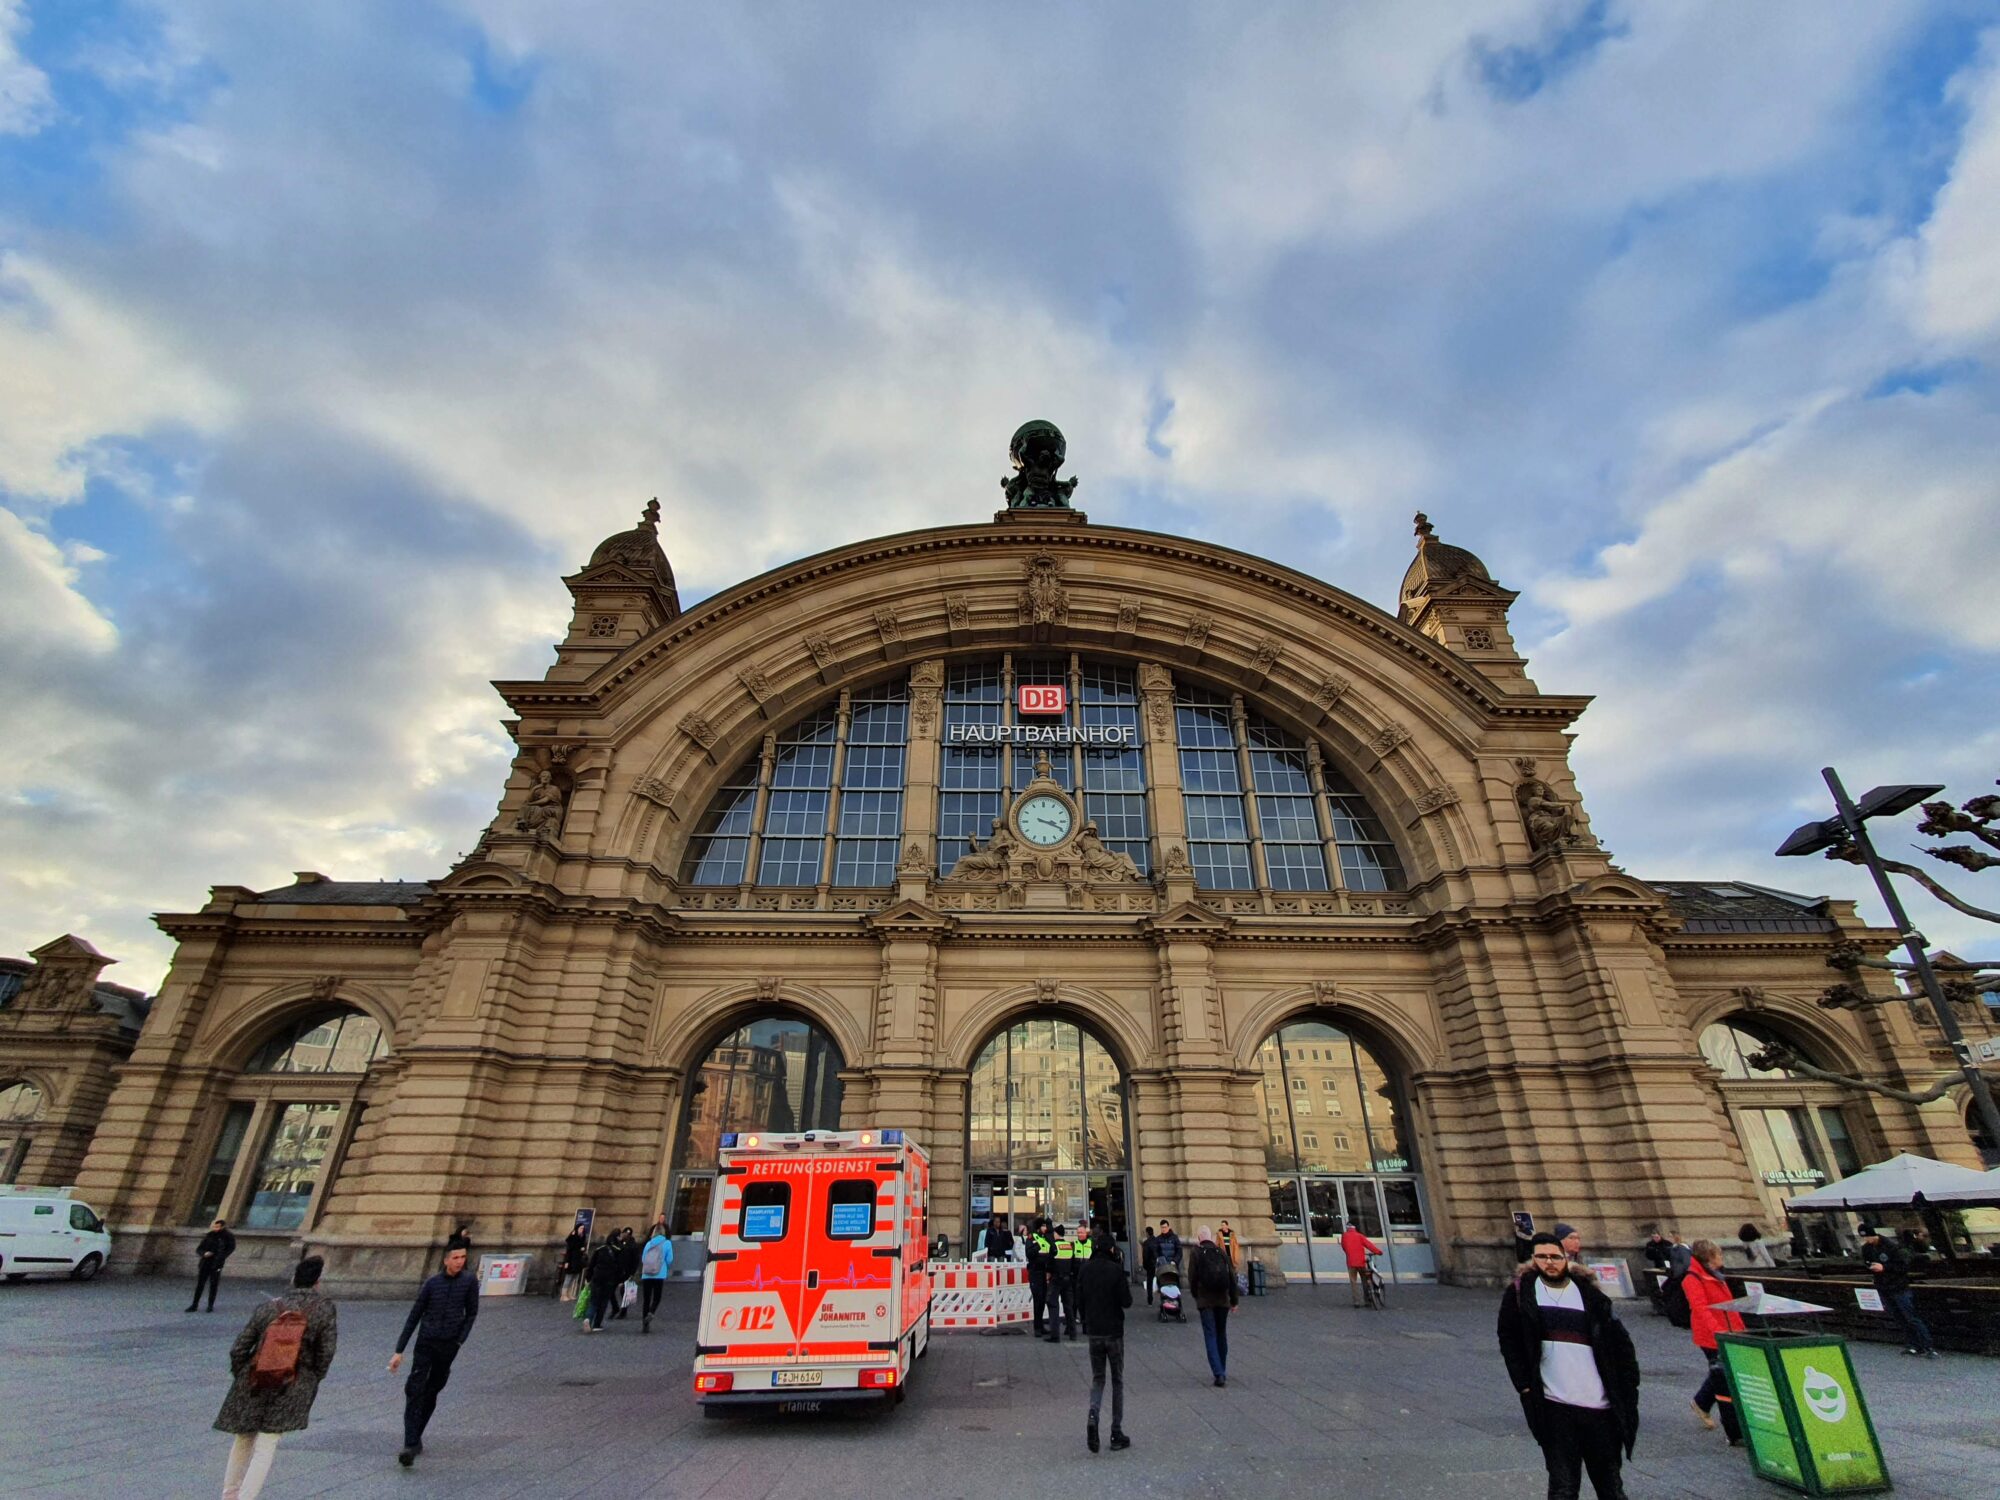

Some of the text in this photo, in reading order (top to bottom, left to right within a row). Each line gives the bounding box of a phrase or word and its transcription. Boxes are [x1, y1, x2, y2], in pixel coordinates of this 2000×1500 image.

[1025, 689, 1059, 708] DB
[950, 725, 1135, 743] HAUPTBAHNHOF
[752, 1161, 872, 1175] RETTUNGSDIENST
[1794, 1168, 1825, 1178] Uddin
[821, 1303, 834, 1312] DIE
[736, 1305, 776, 1331] 112
[819, 1312, 866, 1322] JOHANNITER
[800, 1372, 820, 1382] 6149
